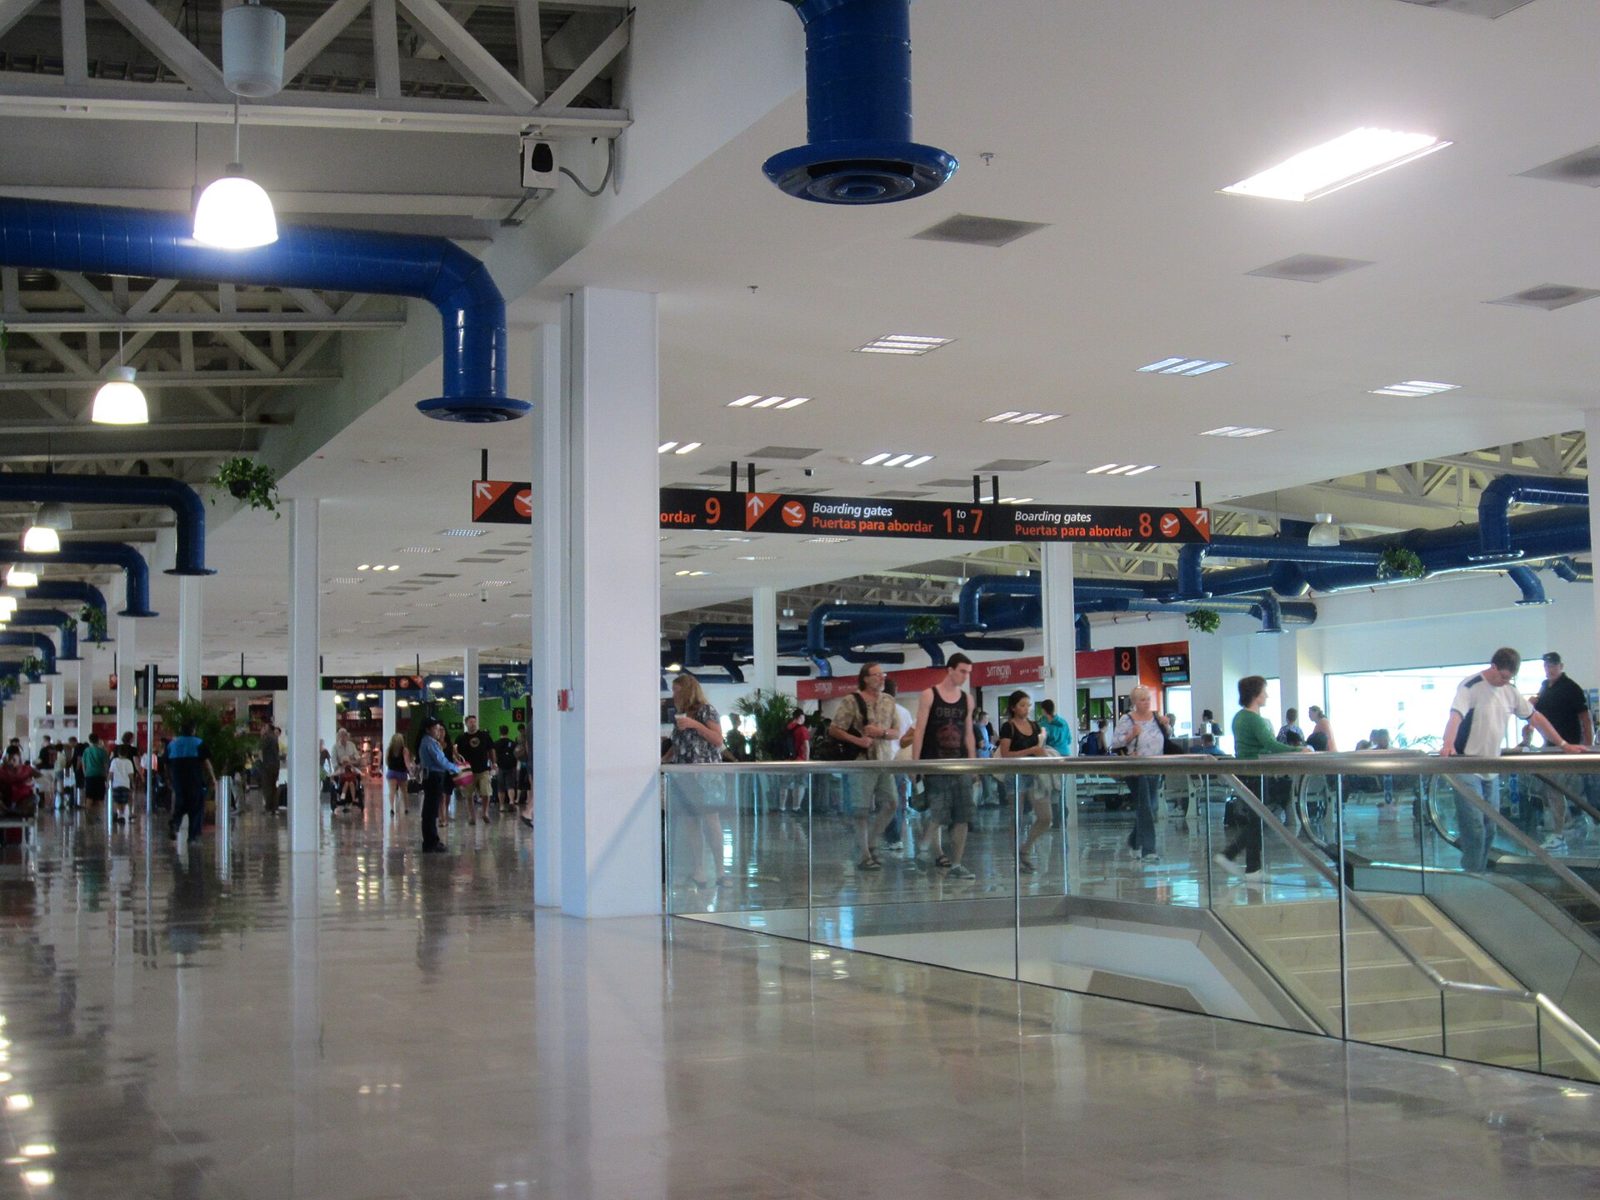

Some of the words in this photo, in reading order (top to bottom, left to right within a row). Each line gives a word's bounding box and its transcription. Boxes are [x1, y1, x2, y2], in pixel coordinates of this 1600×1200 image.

[660, 510, 696, 524] ordar
[705, 497, 721, 525] 9
[812, 502, 861, 518] Boarding
[863, 505, 893, 519] gates
[1015, 511, 1062, 525] Boarding
[1064, 512, 1092, 525] gates
[812, 516, 857, 529] Puertas
[858, 520, 885, 533] para
[887, 519, 934, 533] abordar
[942, 508, 953, 533] 1
[956, 509, 967, 519] to
[970, 509, 983, 534] 7
[958, 525, 965, 533] a
[1139, 513, 1153, 538] 8
[1015, 524, 1057, 536] Puertas
[1061, 526, 1086, 538] para
[1089, 525, 1133, 537] abordar
[1121, 651, 1131, 671] 8
[936, 707, 963, 718] OBEY
